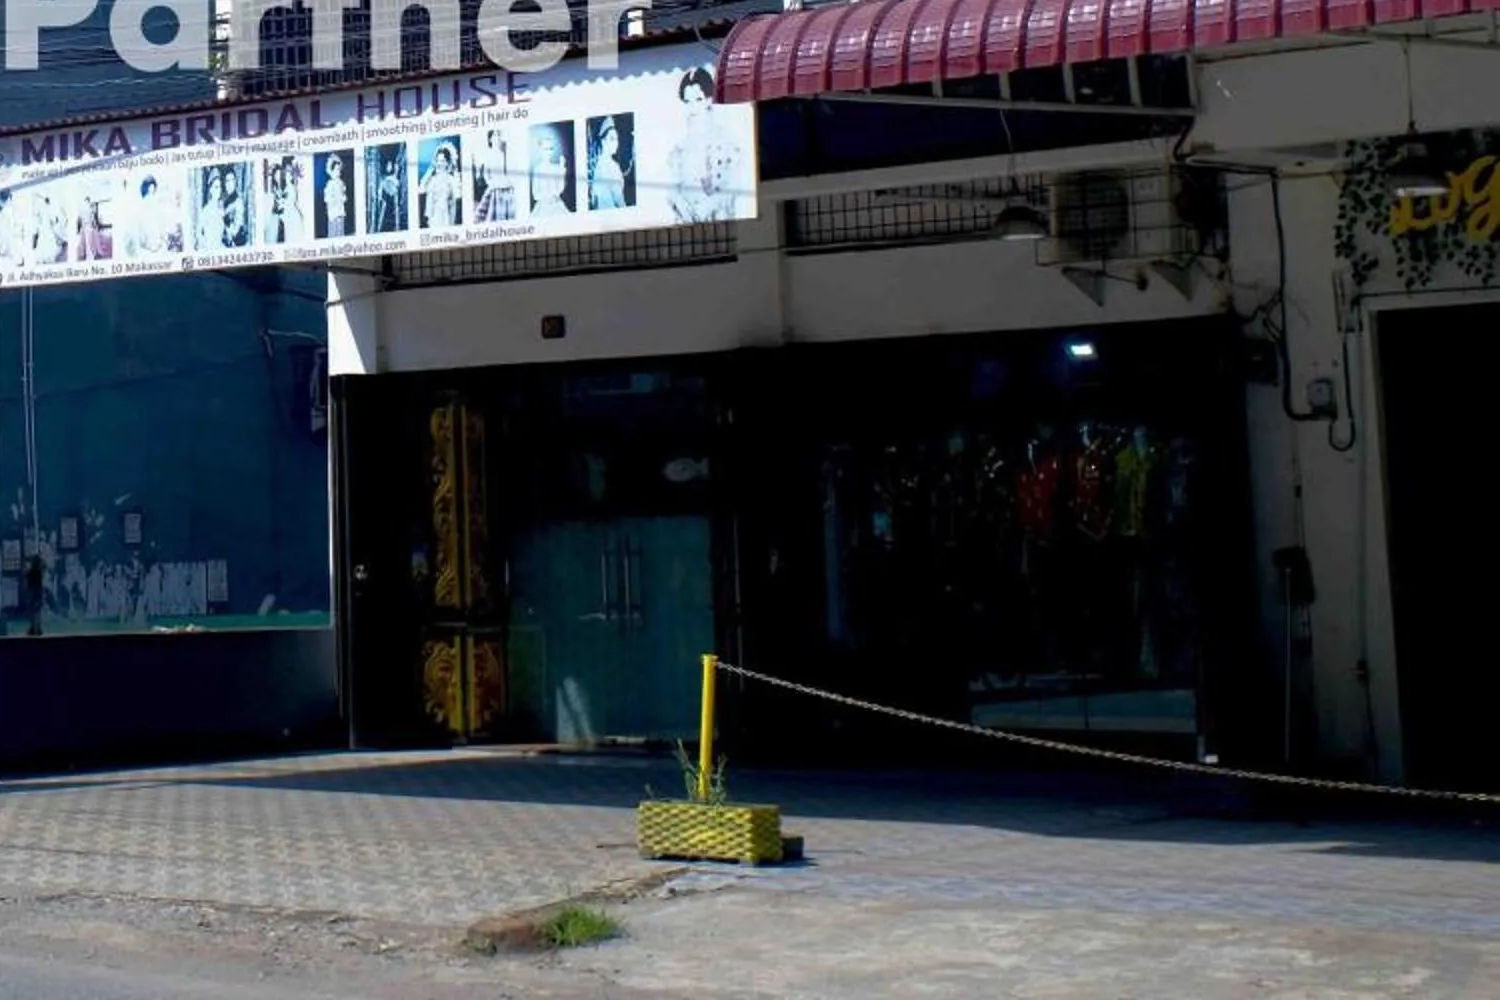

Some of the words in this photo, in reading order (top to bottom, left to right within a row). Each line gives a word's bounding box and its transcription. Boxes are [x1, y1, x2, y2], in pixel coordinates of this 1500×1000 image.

[21, 127, 132, 165] MIKA
[152, 100, 336, 150] BRIDAL
[358, 73, 533, 124] HOUSE
[302, 129, 359, 147] creambath
[365, 119, 427, 139] smoothing
[434, 113, 479, 132] gunting
[488, 110, 510, 123] hair
[513, 107, 529, 119] do
